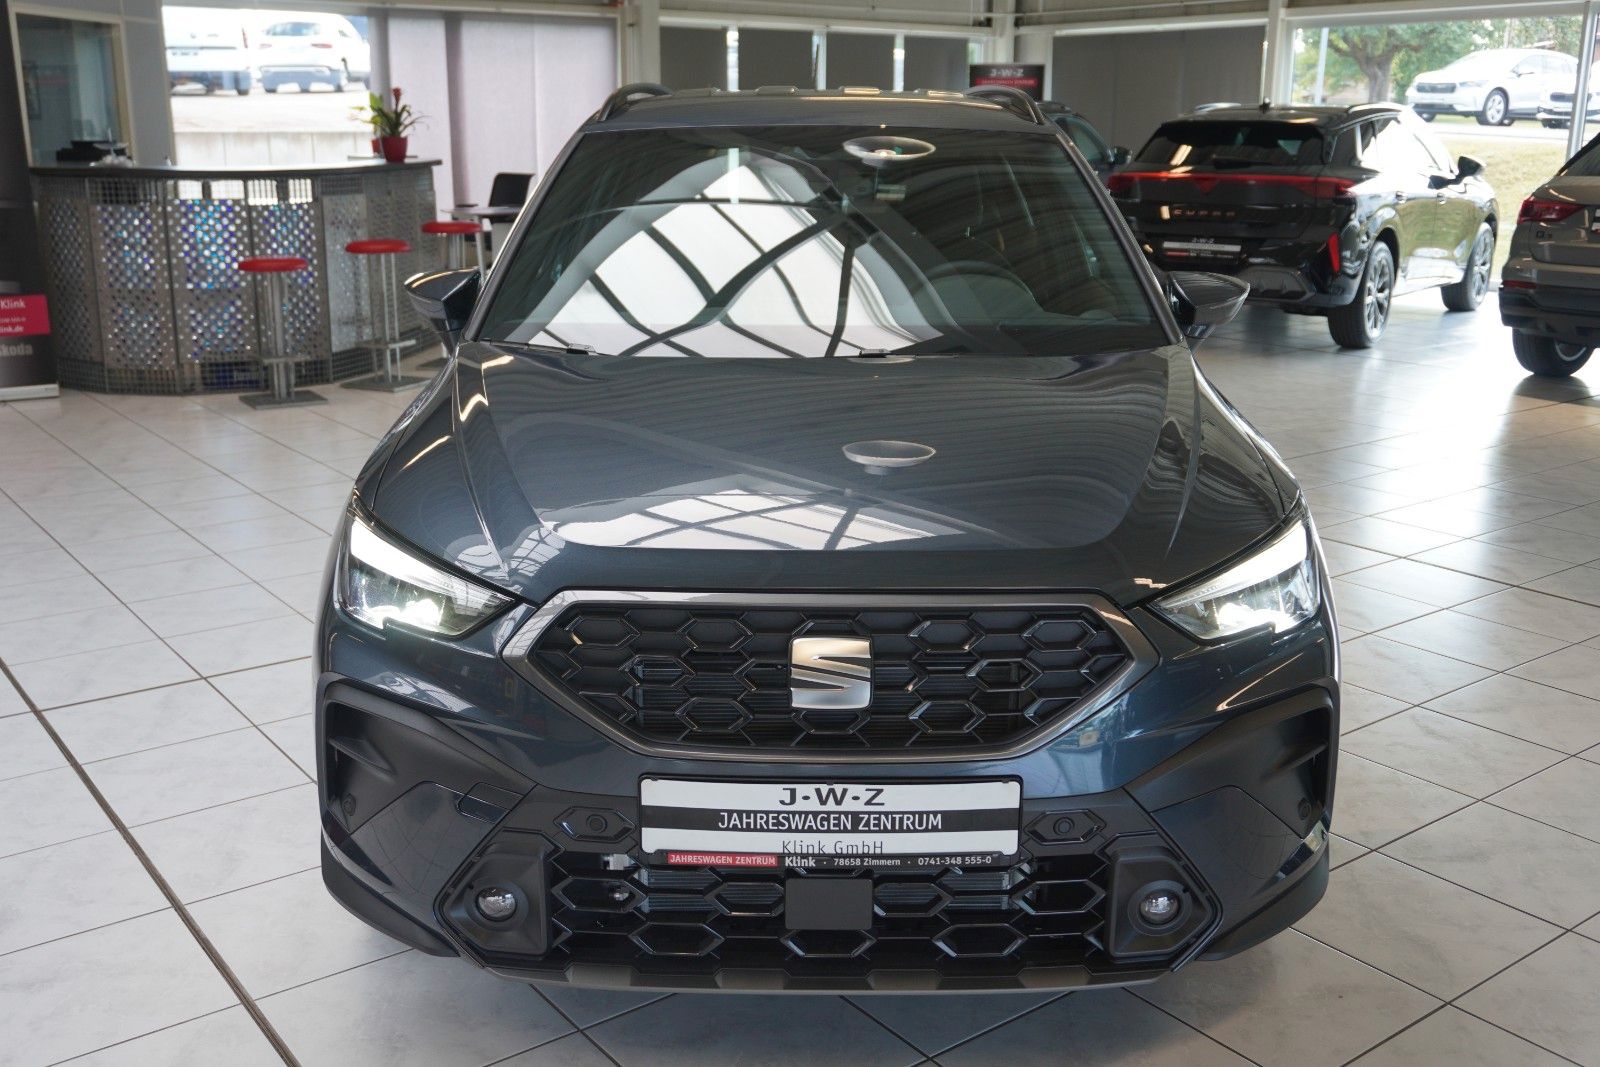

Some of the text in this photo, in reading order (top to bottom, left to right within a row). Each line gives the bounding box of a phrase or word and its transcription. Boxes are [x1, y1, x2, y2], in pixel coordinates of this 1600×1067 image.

[718, 812, 942, 831] JAHRESWAGEN ZENTRUM
[782, 840, 883, 855] Klink GmbH
[670, 854, 992, 867] JAHRESWAGEN ZENTRUM Klink 78658 Zimmern 0741-348 555-0
